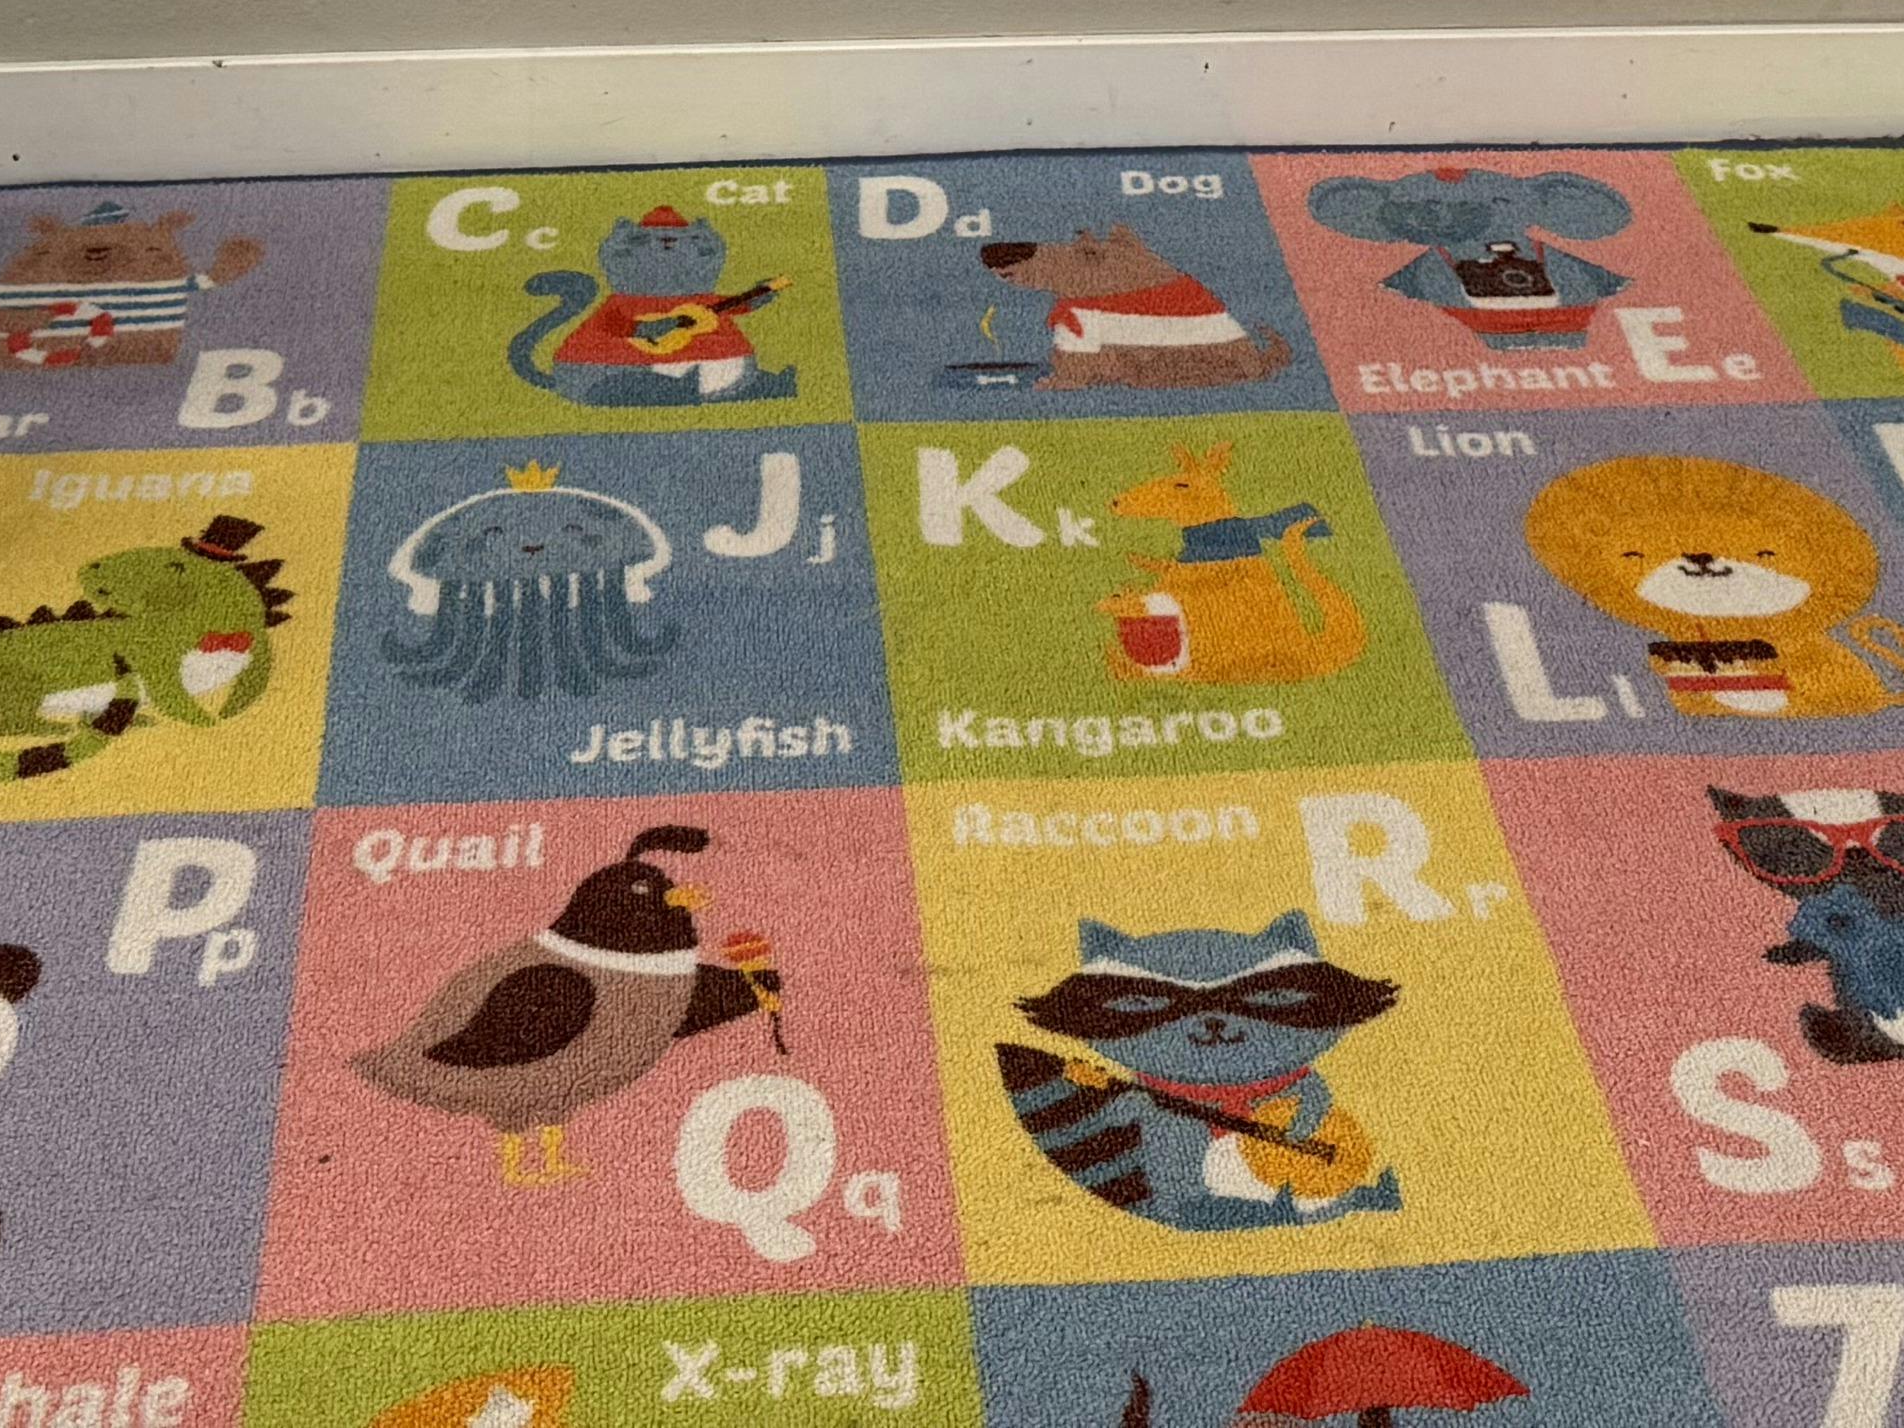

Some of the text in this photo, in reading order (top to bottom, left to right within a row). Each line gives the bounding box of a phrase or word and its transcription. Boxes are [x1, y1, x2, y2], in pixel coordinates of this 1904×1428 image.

[1120, 172, 1224, 199] Dog
[1708, 158, 1796, 183] Fox
[706, 180, 792, 205] Cat
[1358, 362, 1615, 397] Elephant
[1408, 424, 1535, 457] Lion
[29, 466, 254, 512] Iguana
[569, 715, 853, 769] Jellyfish
[937, 705, 1284, 755] Kangaroo
[952, 804, 1259, 847] Raccoon
[351, 823, 543, 878] Quail
[661, 1341, 919, 1411] X-ray
